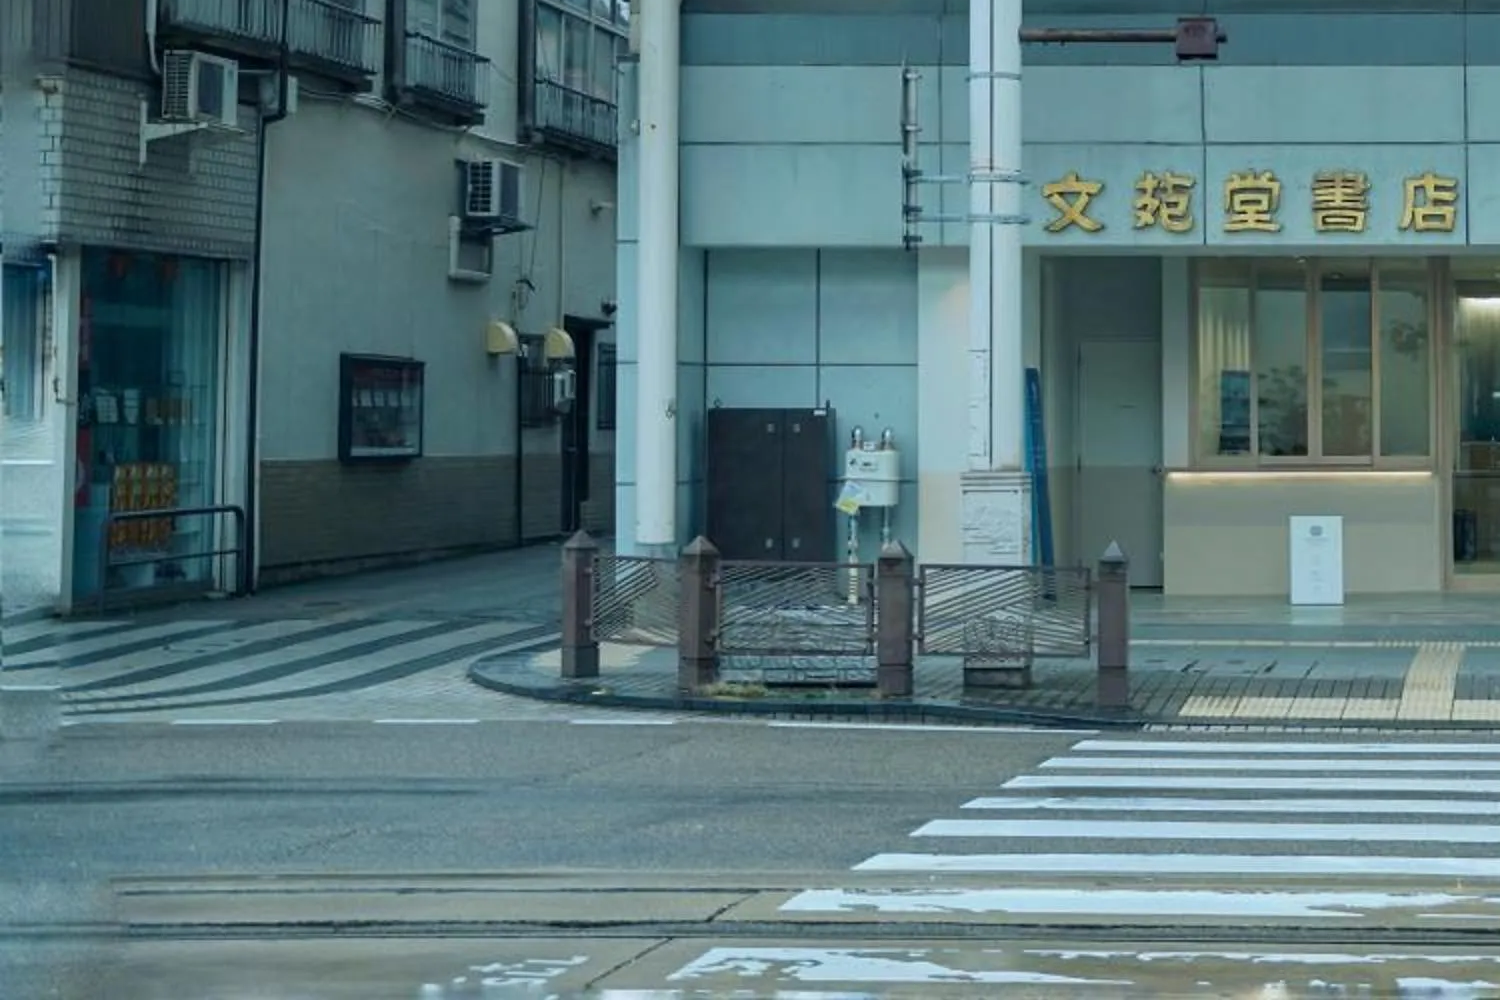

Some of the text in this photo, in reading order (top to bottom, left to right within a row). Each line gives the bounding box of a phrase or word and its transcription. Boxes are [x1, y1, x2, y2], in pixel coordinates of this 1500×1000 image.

[1041, 169, 1459, 234] 文苑堂書店
